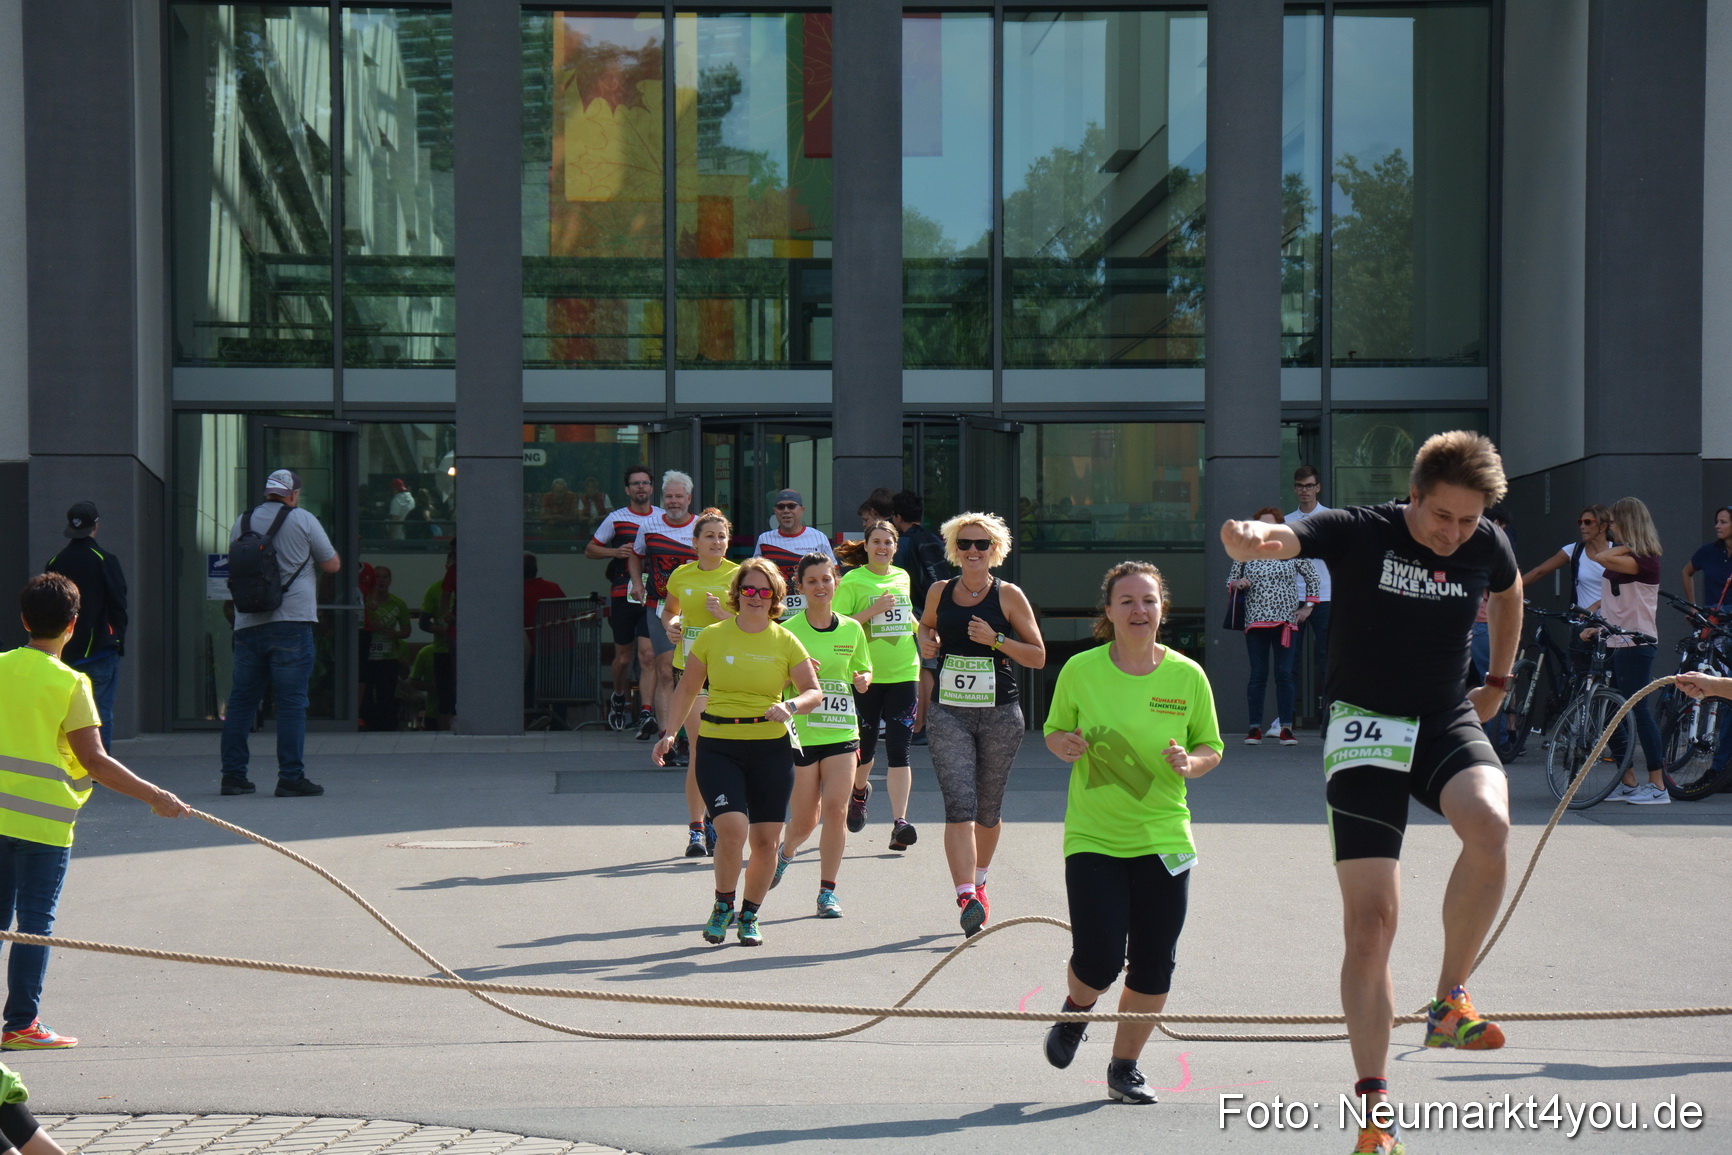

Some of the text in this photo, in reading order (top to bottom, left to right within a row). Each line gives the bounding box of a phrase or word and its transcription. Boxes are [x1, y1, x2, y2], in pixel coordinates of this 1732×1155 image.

[524, 452, 541, 462] NG
[1382, 558, 1433, 583] SWIM.
[1380, 570, 1468, 598] BIKE.RUN.
[786, 596, 802, 608] 89
[884, 609, 902, 622] 95
[946, 658, 989, 670] BOCK
[954, 674, 977, 690] 67
[943, 691, 990, 701] ANNA-MARIA
[821, 696, 848, 712] 149
[821, 715, 847, 723] TANJA
[1343, 720, 1382, 742] 94
[1332, 747, 1393, 763] THOMAS
